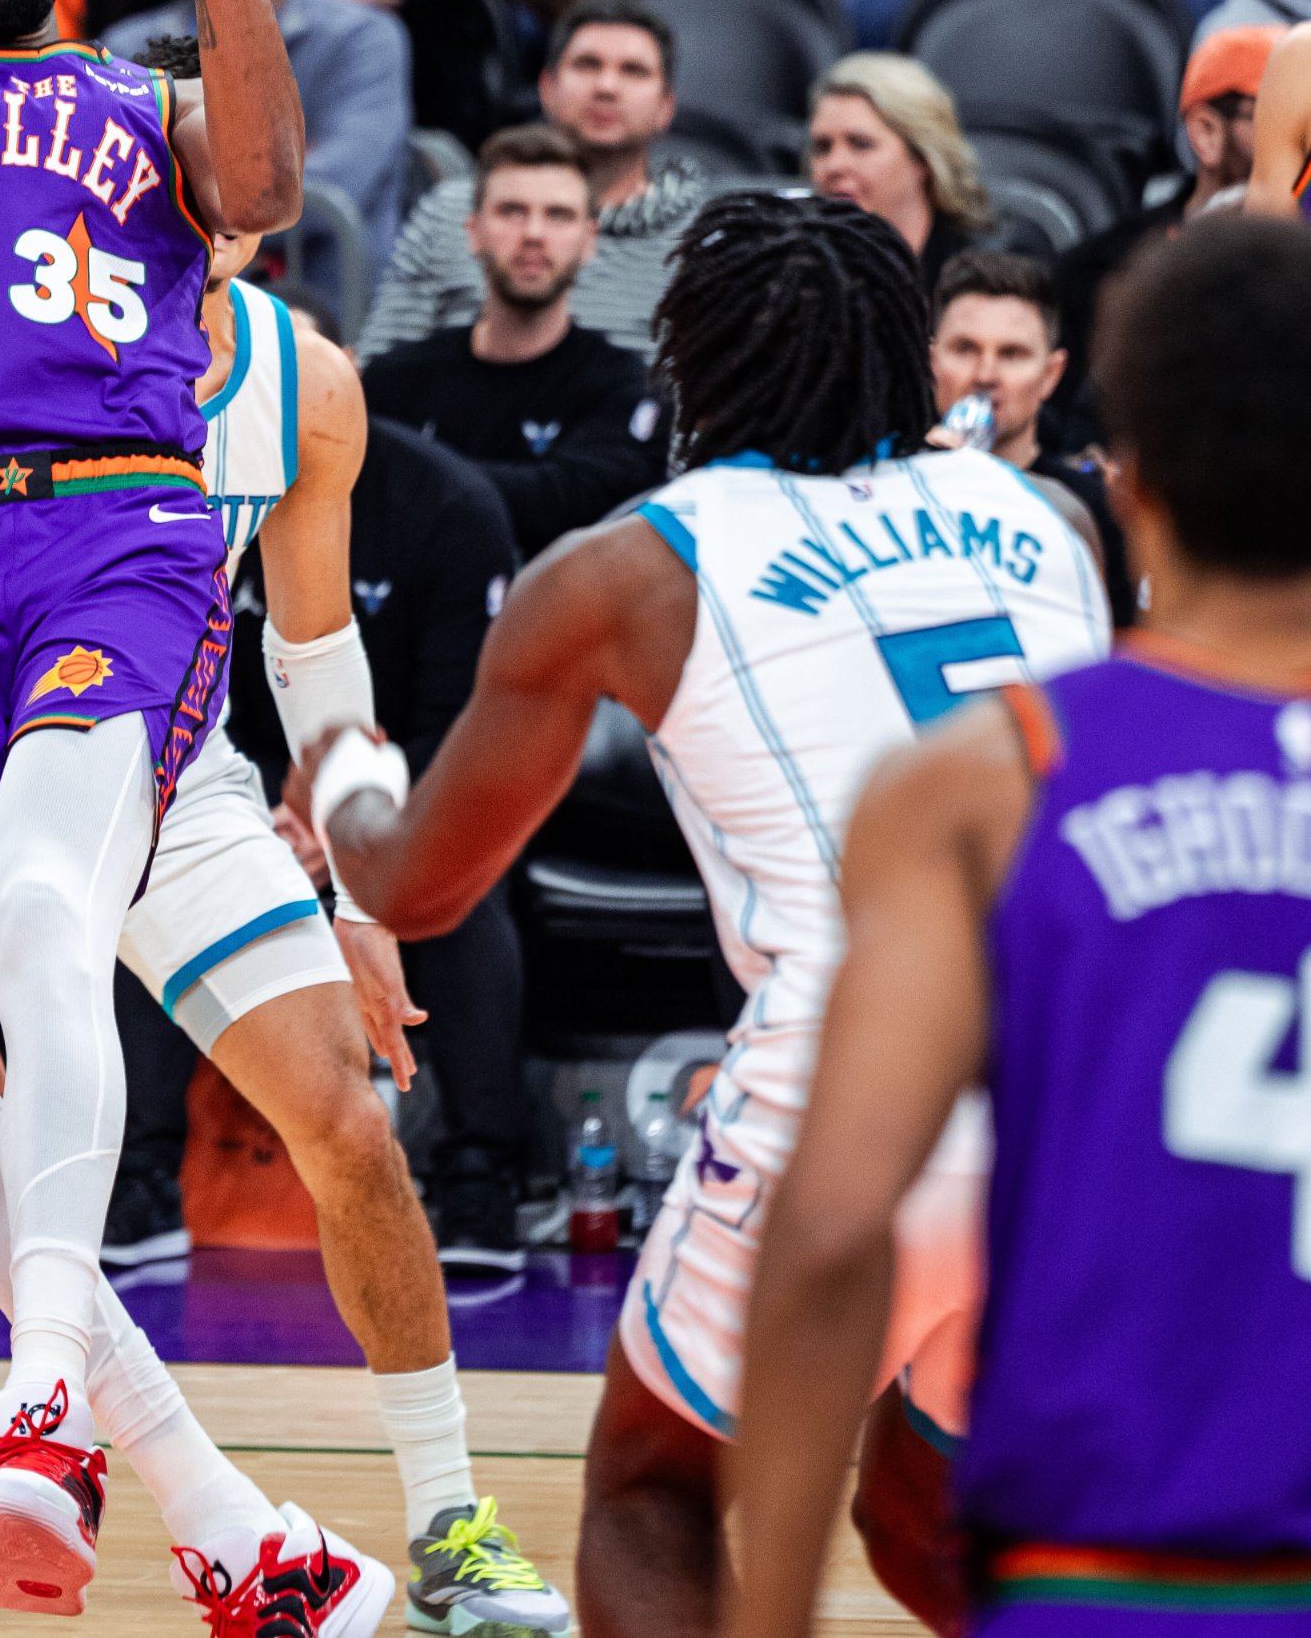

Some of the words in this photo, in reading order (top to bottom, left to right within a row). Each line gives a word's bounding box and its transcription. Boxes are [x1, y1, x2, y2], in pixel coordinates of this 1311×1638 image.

[11, 74, 78, 99] THE
[8, 228, 149, 344] 35
[747, 508, 1045, 617] WILLIAMS
